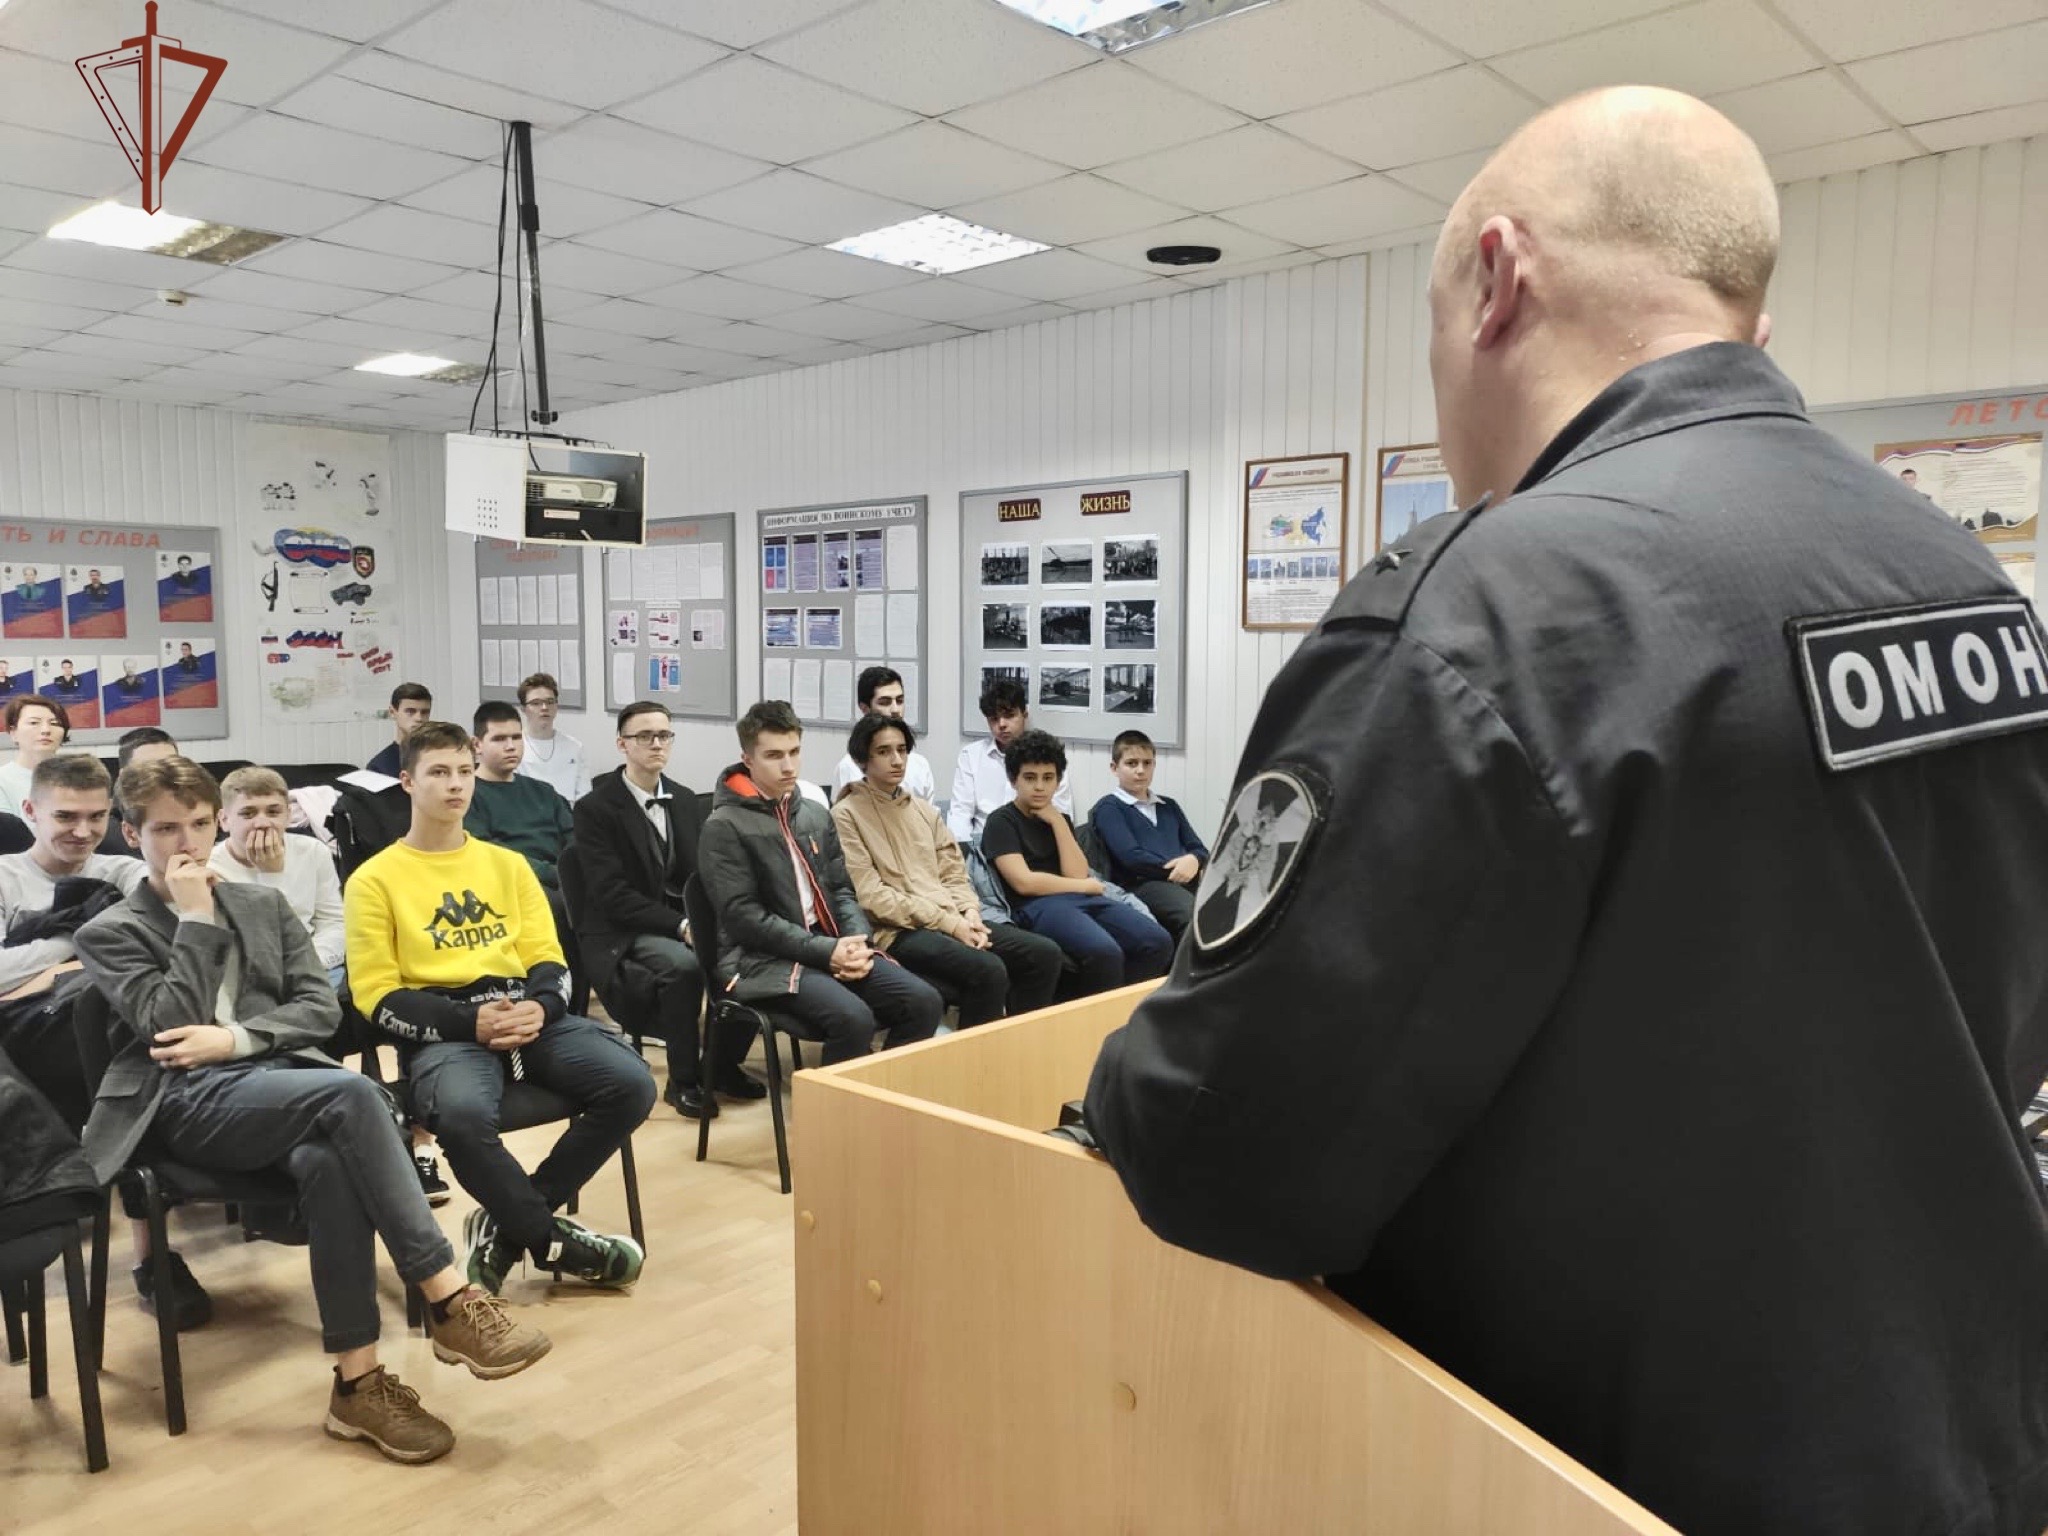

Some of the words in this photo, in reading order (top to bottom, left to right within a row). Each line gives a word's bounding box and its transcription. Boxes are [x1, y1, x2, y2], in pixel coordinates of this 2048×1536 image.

[1000, 502, 1040, 519] НАША
[1081, 494, 1130, 513] ЖИЗНЬ
[48, 527, 66, 544] И
[78, 529, 161, 548] СЛАВА
[1828, 626, 2048, 729] ОМОН
[433, 922, 507, 950] Kappa
